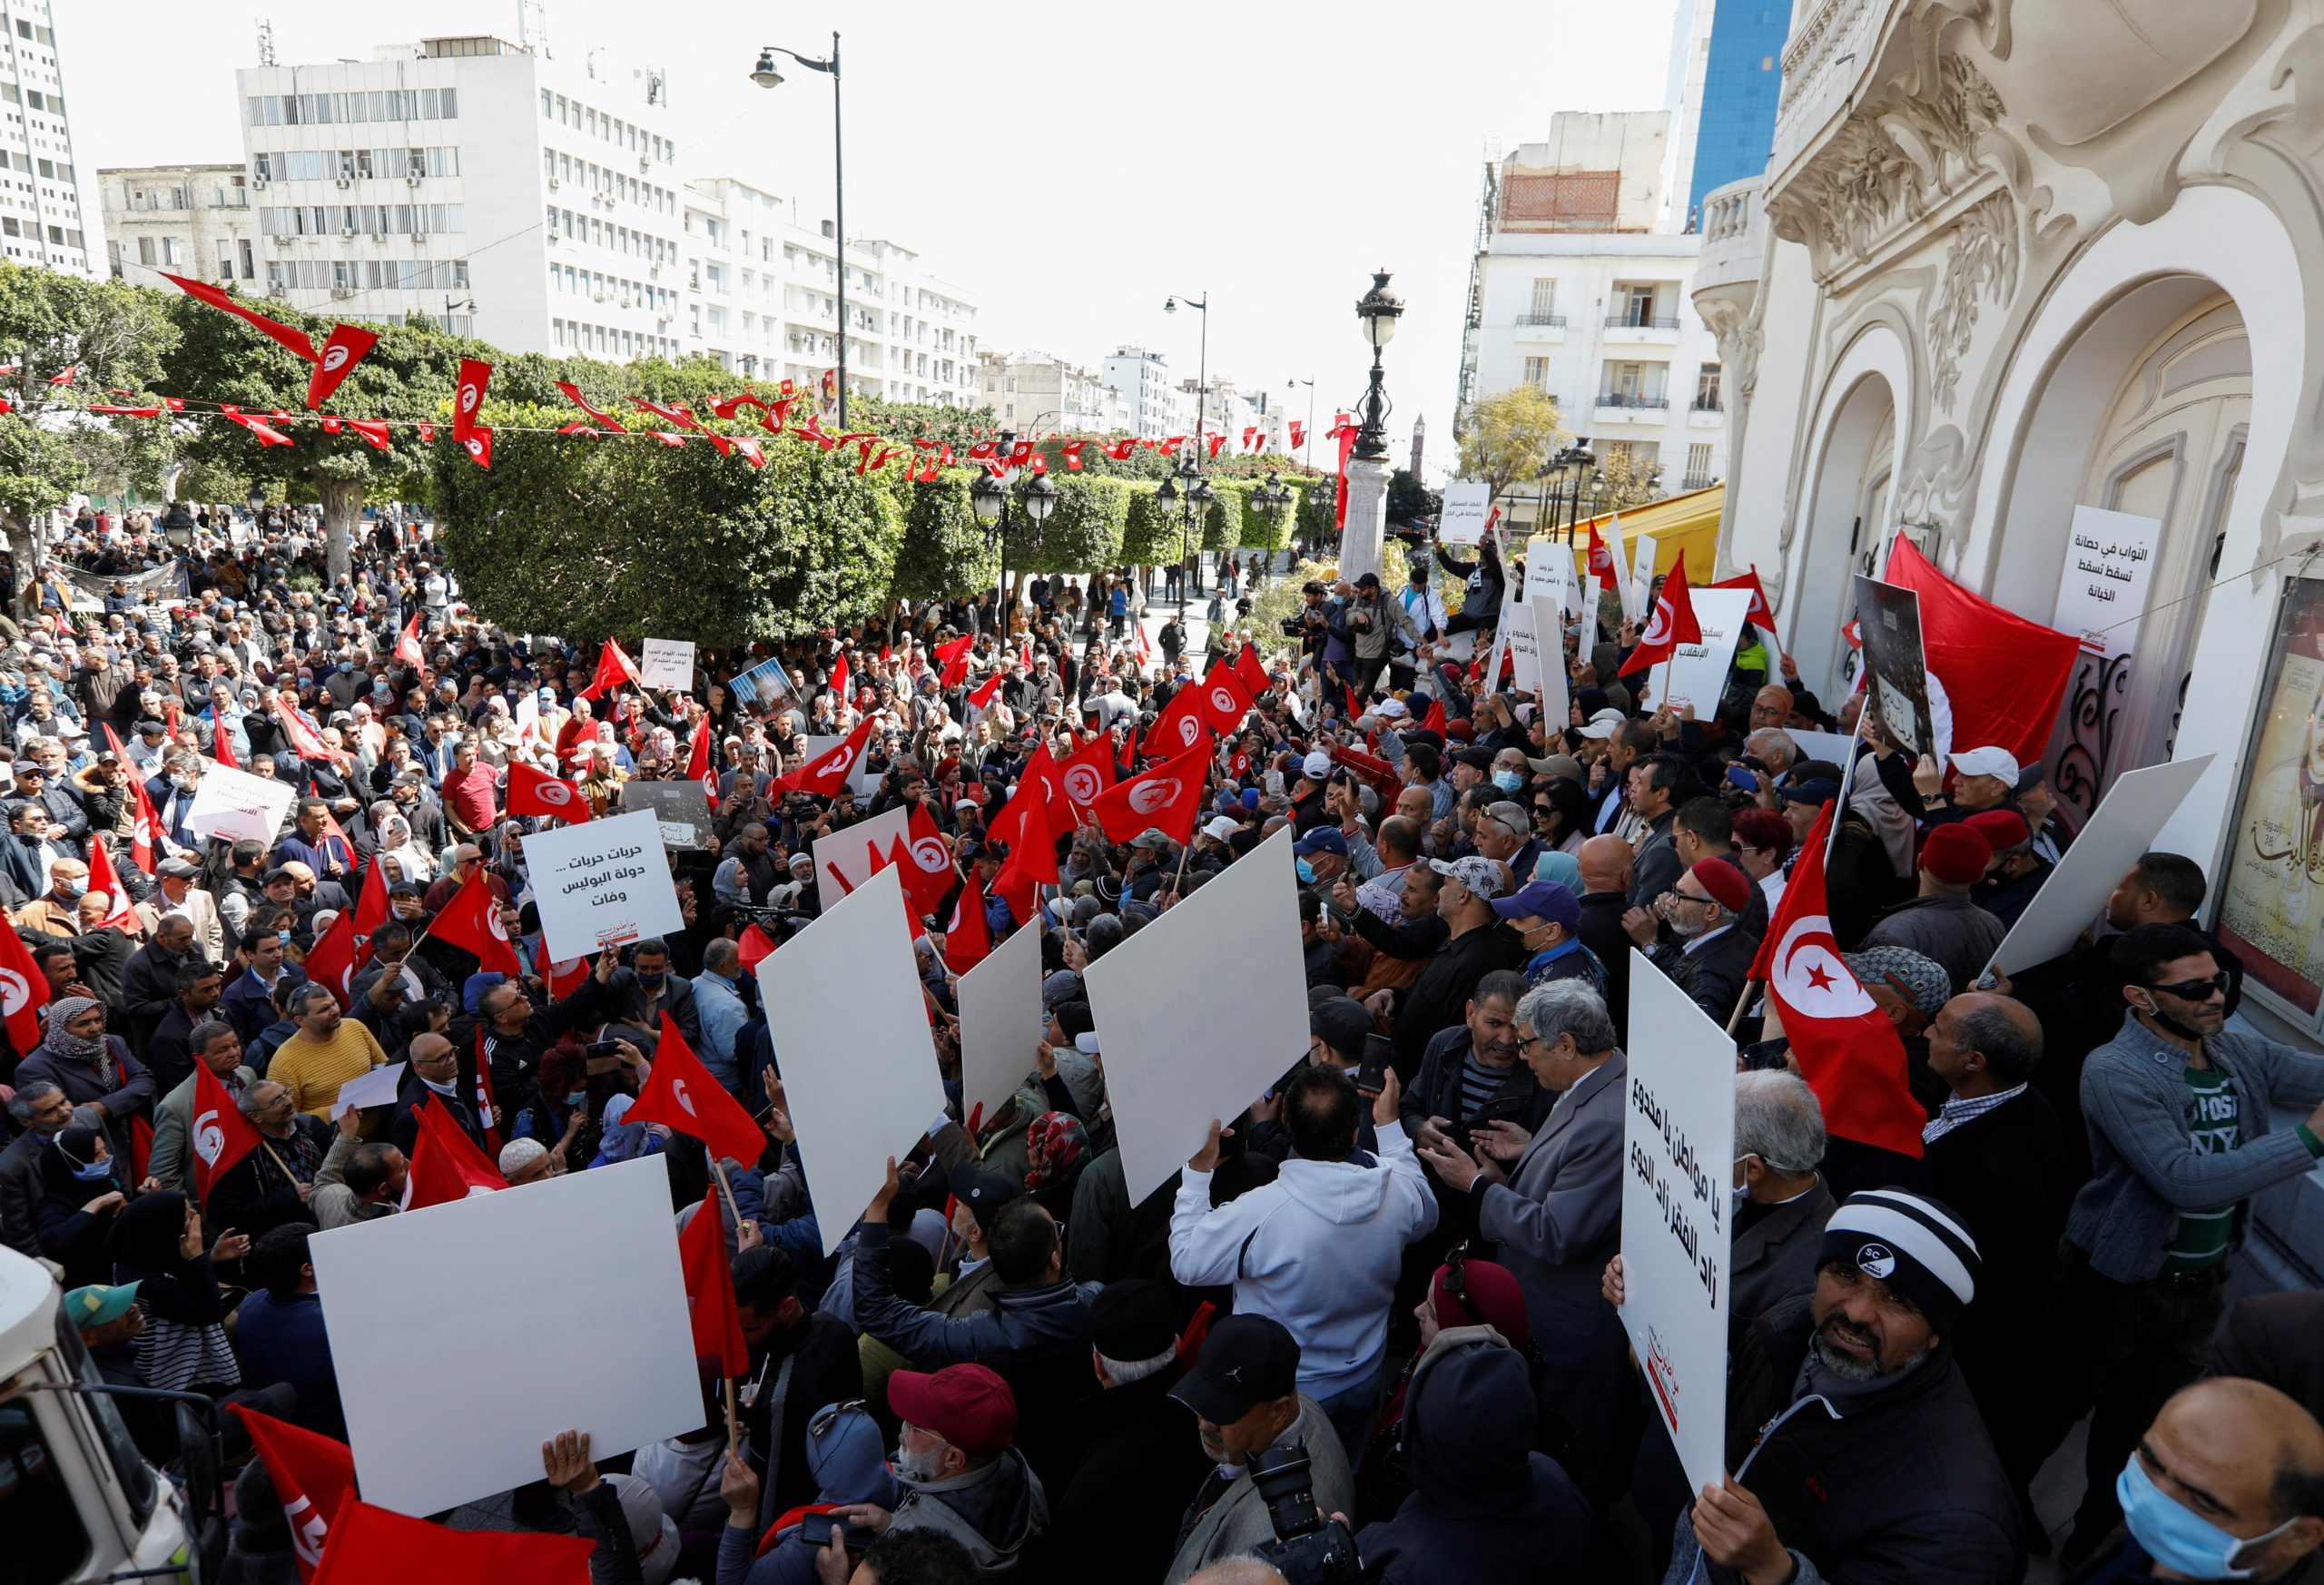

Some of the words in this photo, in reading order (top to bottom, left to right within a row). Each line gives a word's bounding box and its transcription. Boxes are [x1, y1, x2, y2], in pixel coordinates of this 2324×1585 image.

[2074, 534, 2099, 550] حصانة
[2101, 542, 2116, 558] في
[2077, 558, 2104, 575] تسقط
[2105, 565, 2133, 582] تسقط
[2088, 584, 2115, 602] الخيانة
[1512, 630, 1530, 638] مخدوع
[1514, 645, 1529, 654] الجوع
[2264, 834, 2274, 847] 38
[568, 853, 605, 869] حريات
[607, 845, 642, 860] حريات
[615, 865, 645, 879] دولة
[562, 871, 612, 894] البوليس
[591, 891, 627, 906] وفات
[1632, 1077, 1662, 1131] مخدوع
[1664, 1108, 1671, 1156] يا
[1631, 1140, 1654, 1190] الجوع
[1672, 1126, 1709, 1203] مواطن
[1656, 1177, 1669, 1224] زاد
[1711, 1178, 1720, 1235] يا
[1670, 1202, 1698, 1267] الفقر
[1865, 1247, 1880, 1259] SC
[1699, 1255, 1717, 1310] زاد
